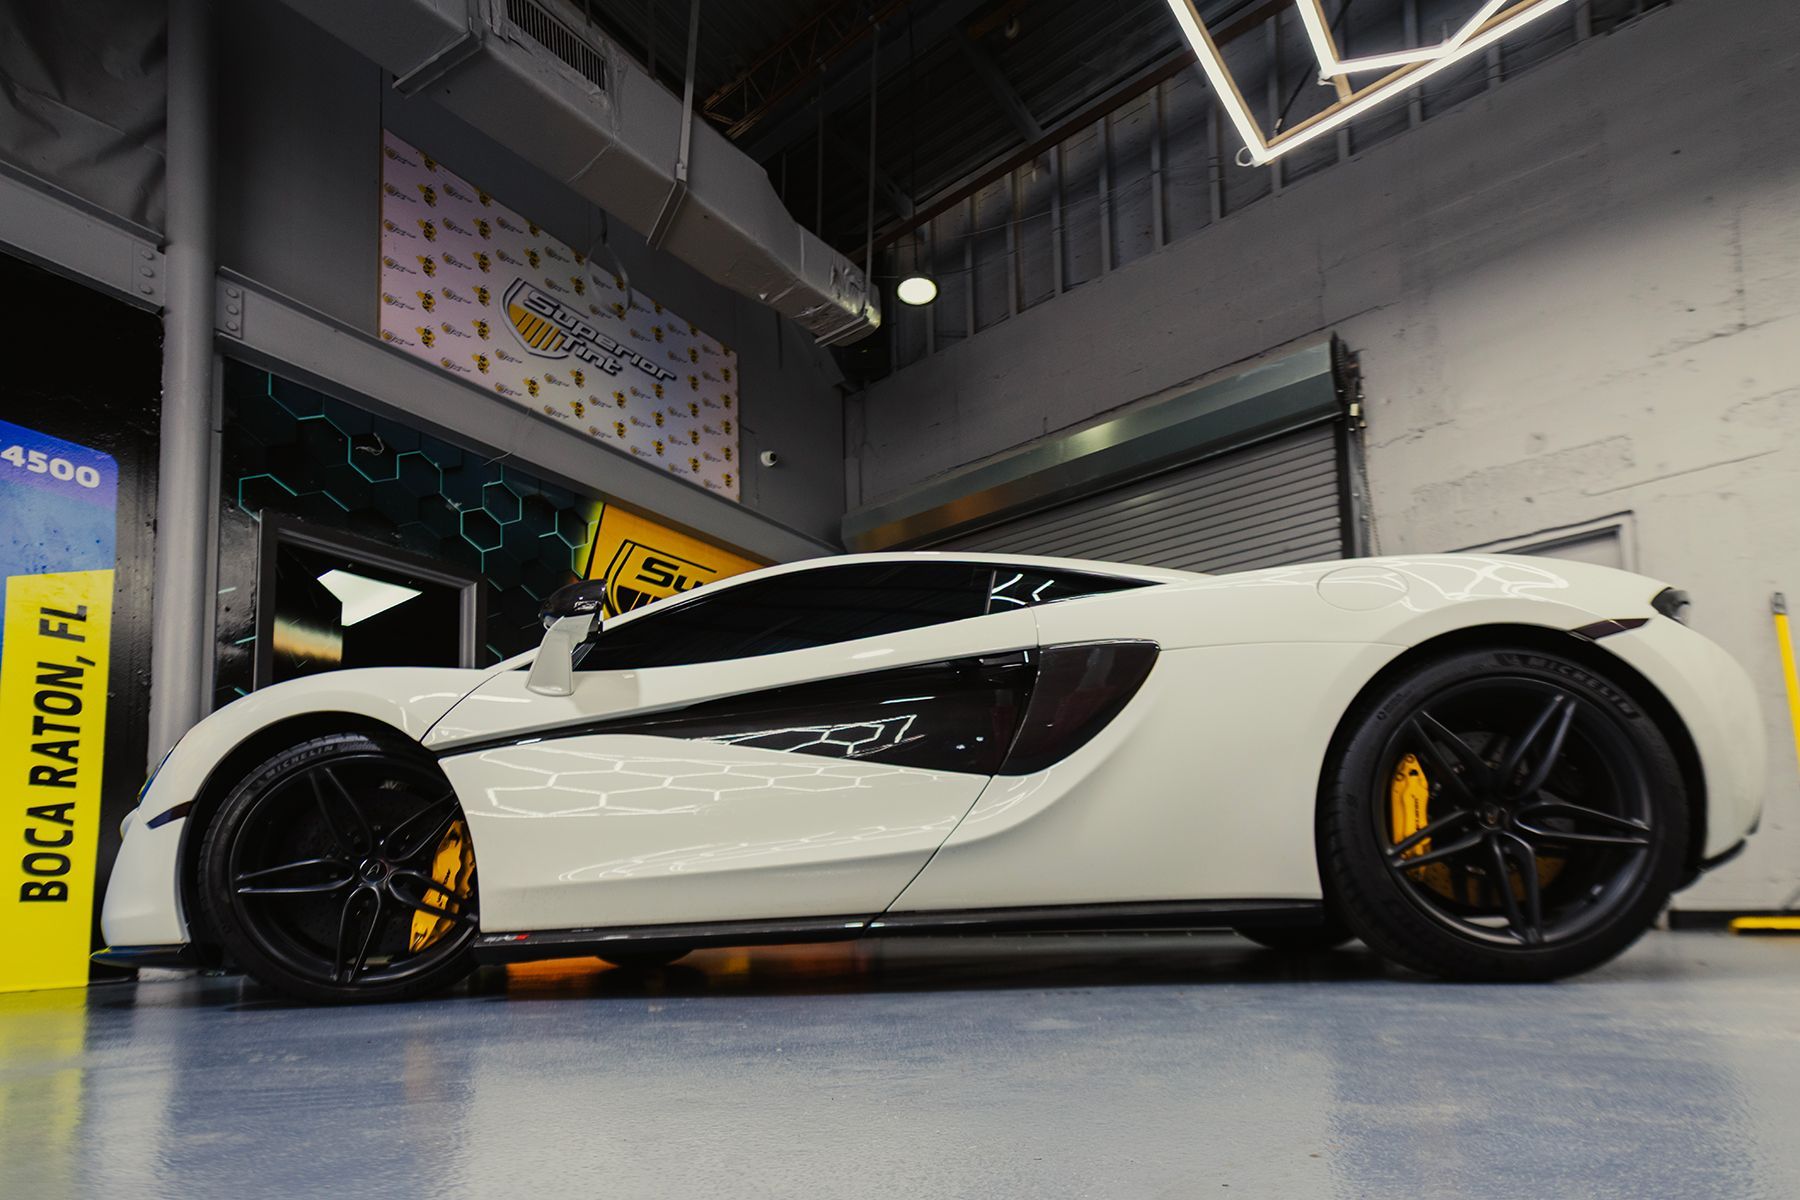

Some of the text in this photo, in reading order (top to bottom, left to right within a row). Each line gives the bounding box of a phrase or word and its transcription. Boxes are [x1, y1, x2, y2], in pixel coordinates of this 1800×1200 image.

[523, 290, 677, 381] Superior
[559, 329, 623, 376] Tint
[1, 445, 100, 489] 4500
[1526, 655, 1641, 719] MICHELIN
[19, 605, 96, 903] BOCA RATON, FL
[265, 745, 334, 778] MICHELIN
